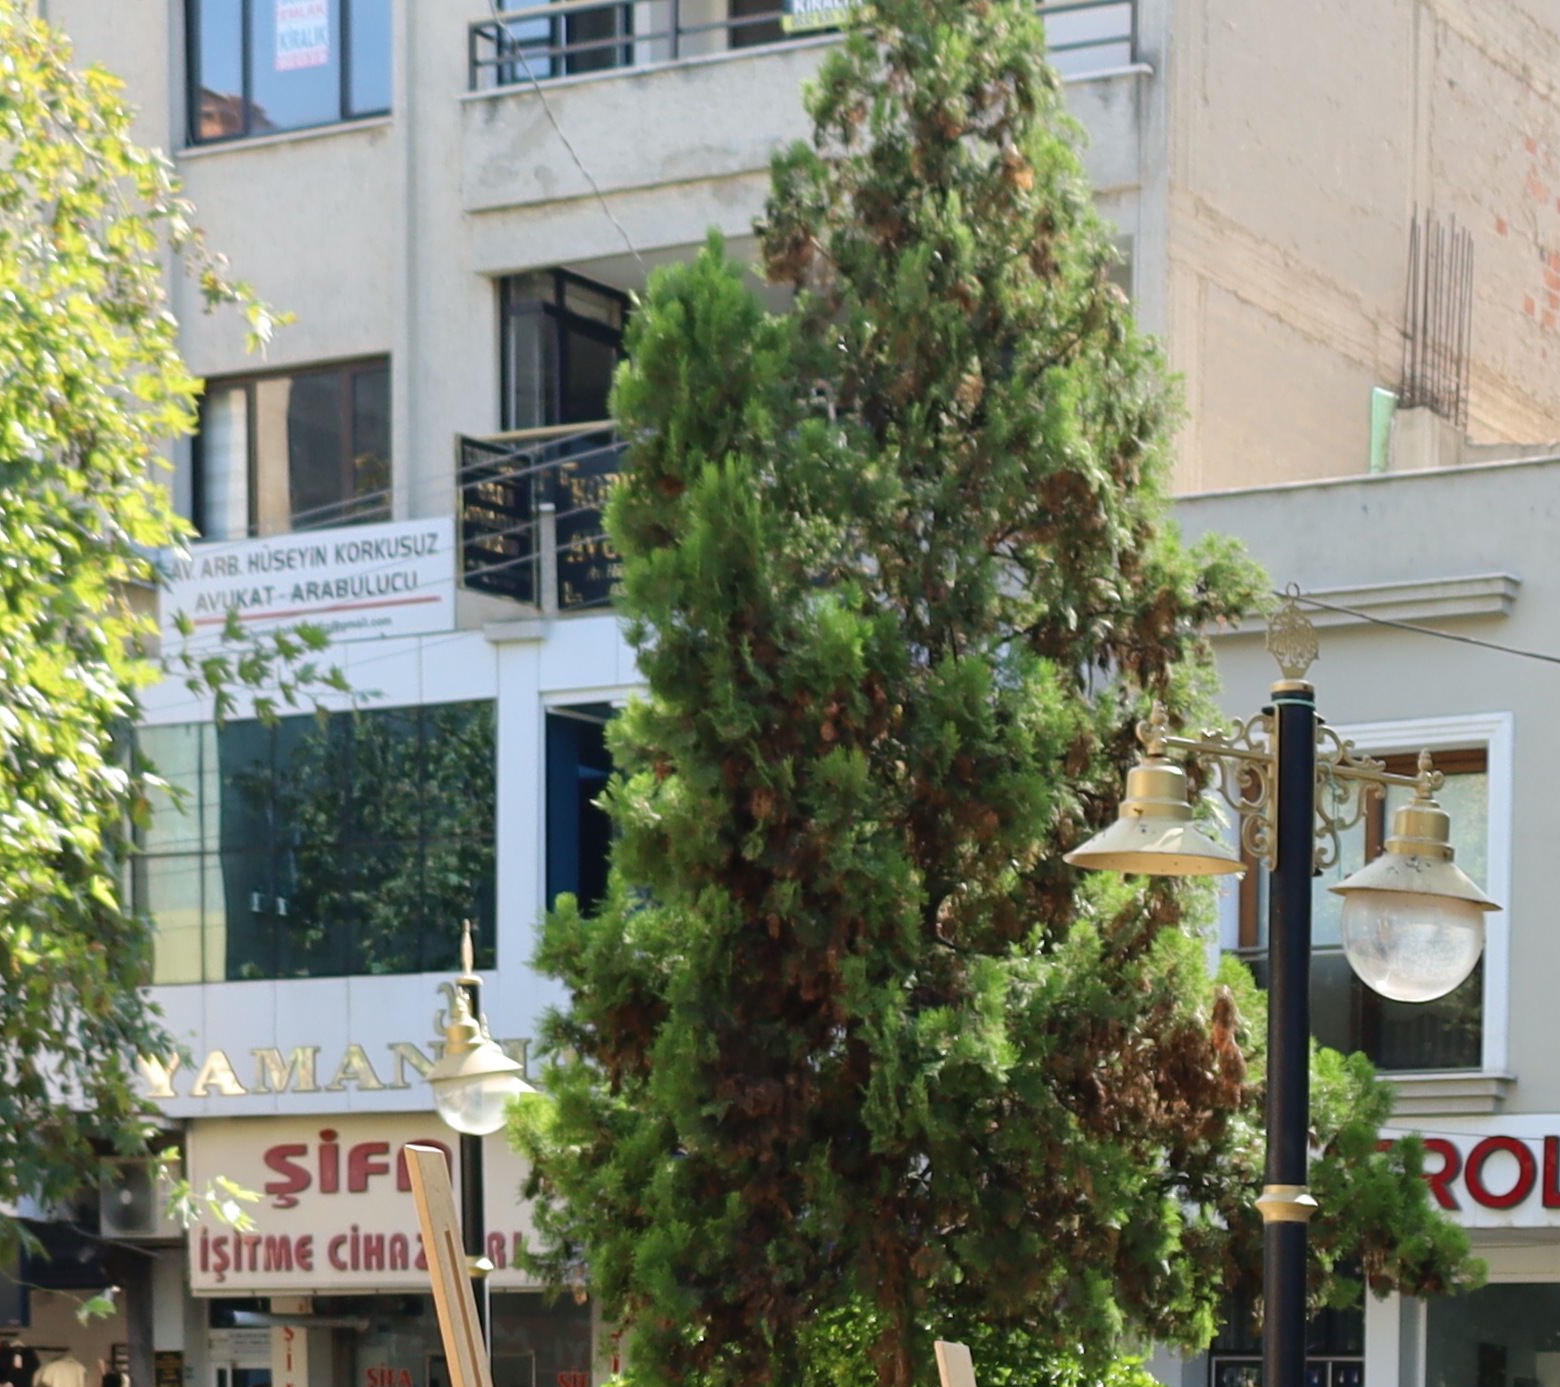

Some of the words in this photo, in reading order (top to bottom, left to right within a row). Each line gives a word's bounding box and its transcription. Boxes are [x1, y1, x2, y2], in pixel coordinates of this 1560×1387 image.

[200, 553, 243, 579] ARB.
[247, 544, 328, 573] HÜSEYİN
[335, 533, 438, 563] KORKUSUZ
[195, 585, 274, 613] AVUKAT
[292, 571, 418, 603] ARABULUCU
[200, 1226, 314, 1283] İŞİTME
